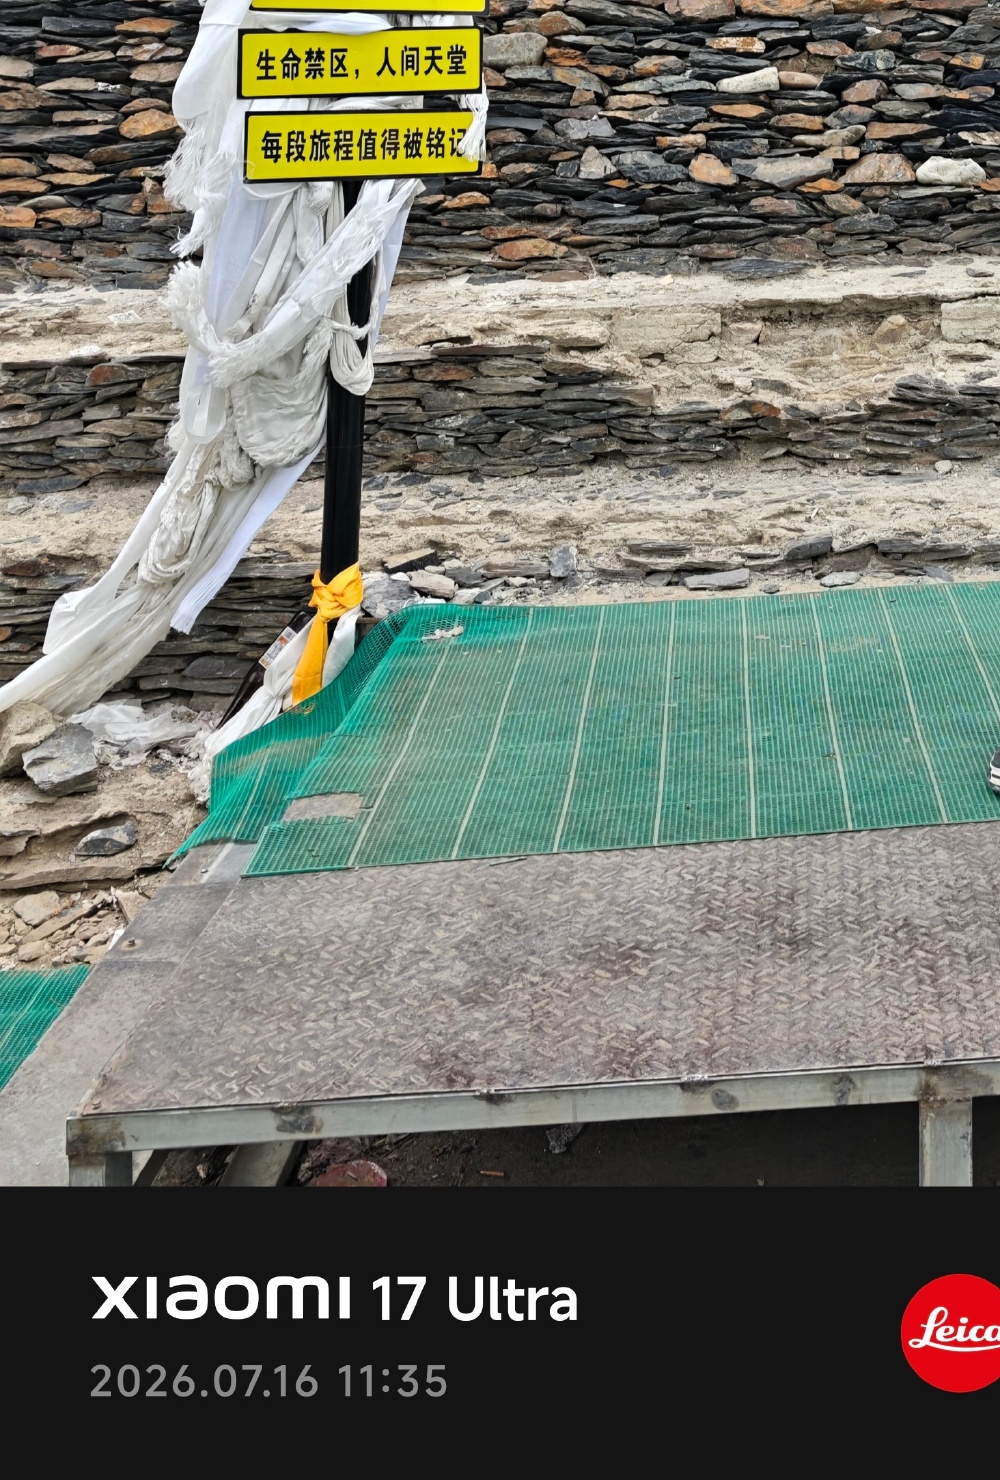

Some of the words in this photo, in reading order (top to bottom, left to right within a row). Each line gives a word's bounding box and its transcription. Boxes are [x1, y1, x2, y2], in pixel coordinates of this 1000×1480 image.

[256, 44, 468, 81] 生命禁区，人间天堂
